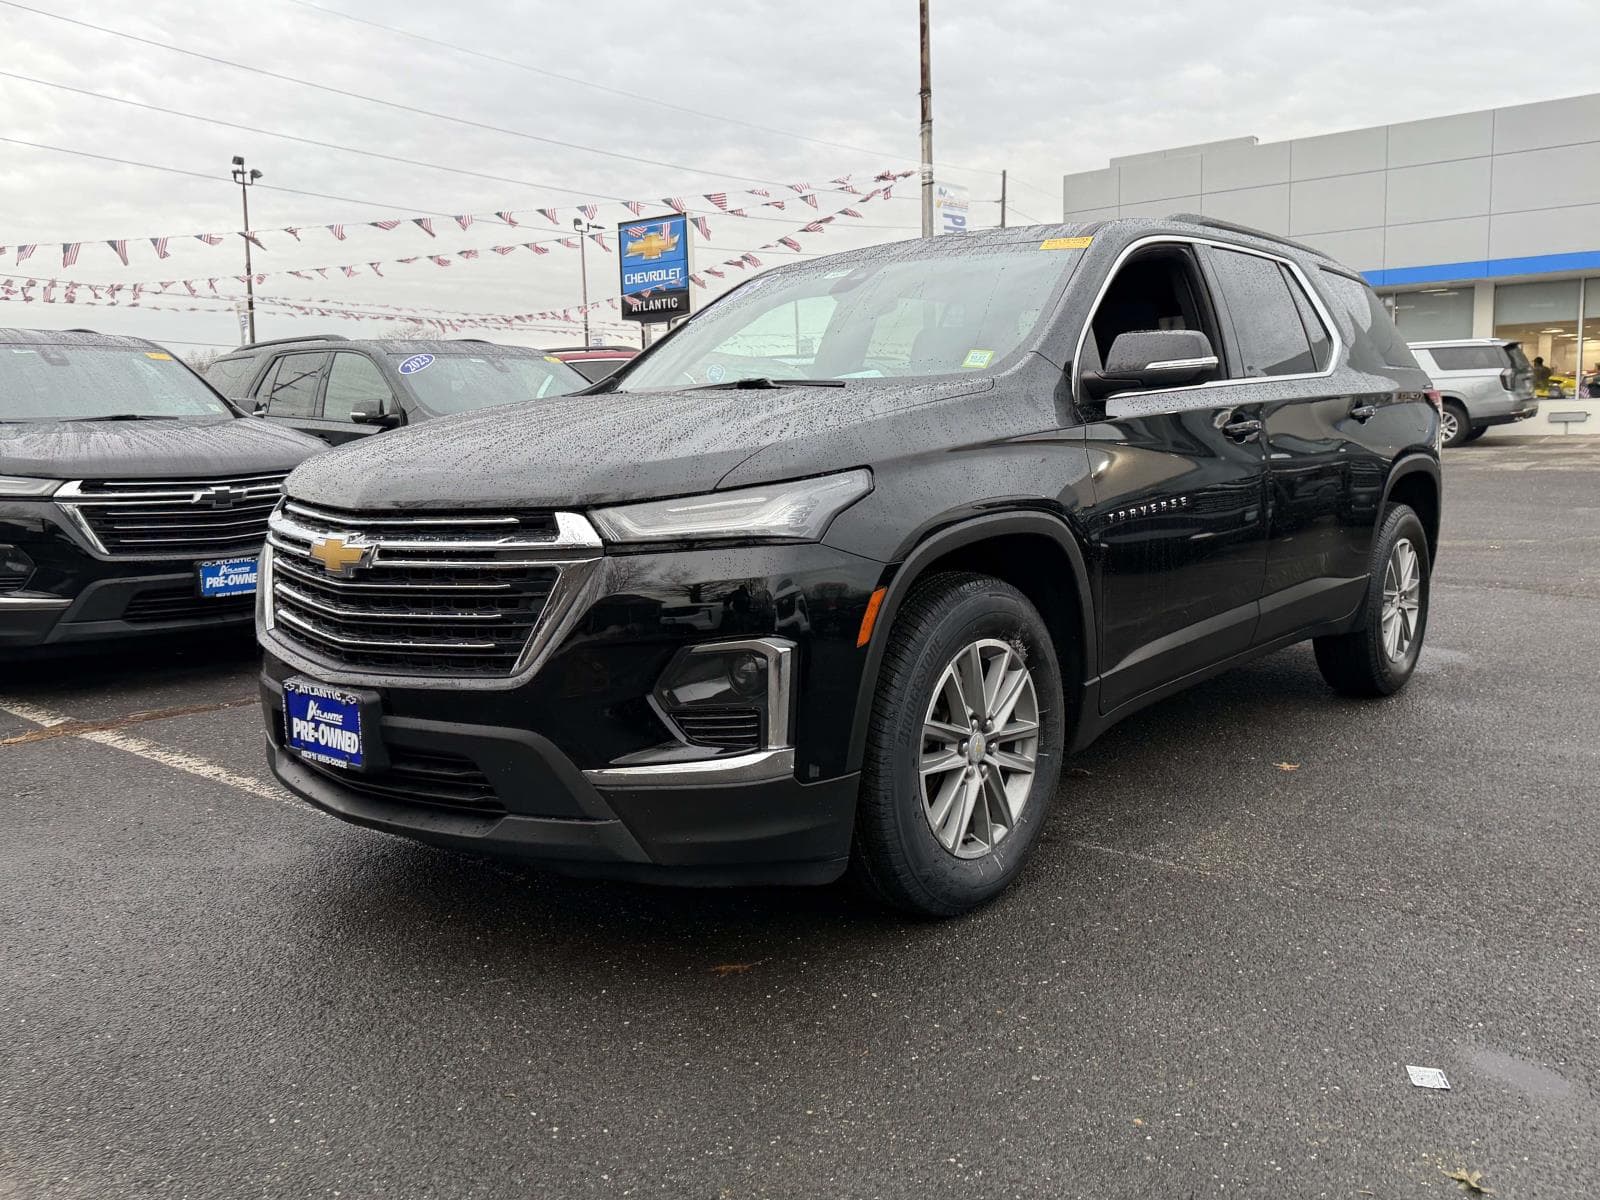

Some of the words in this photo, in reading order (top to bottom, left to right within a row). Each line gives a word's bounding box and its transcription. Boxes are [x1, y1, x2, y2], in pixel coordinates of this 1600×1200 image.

[625, 267, 681, 285] CHEVROLET
[632, 297, 678, 312] ATLANTIC
[1108, 496, 1187, 523] TRAVERSE
[216, 557, 251, 566] ATLANTIC
[300, 684, 342, 701] ATLANTIC
[292, 717, 359, 754] PRE-OWNED
